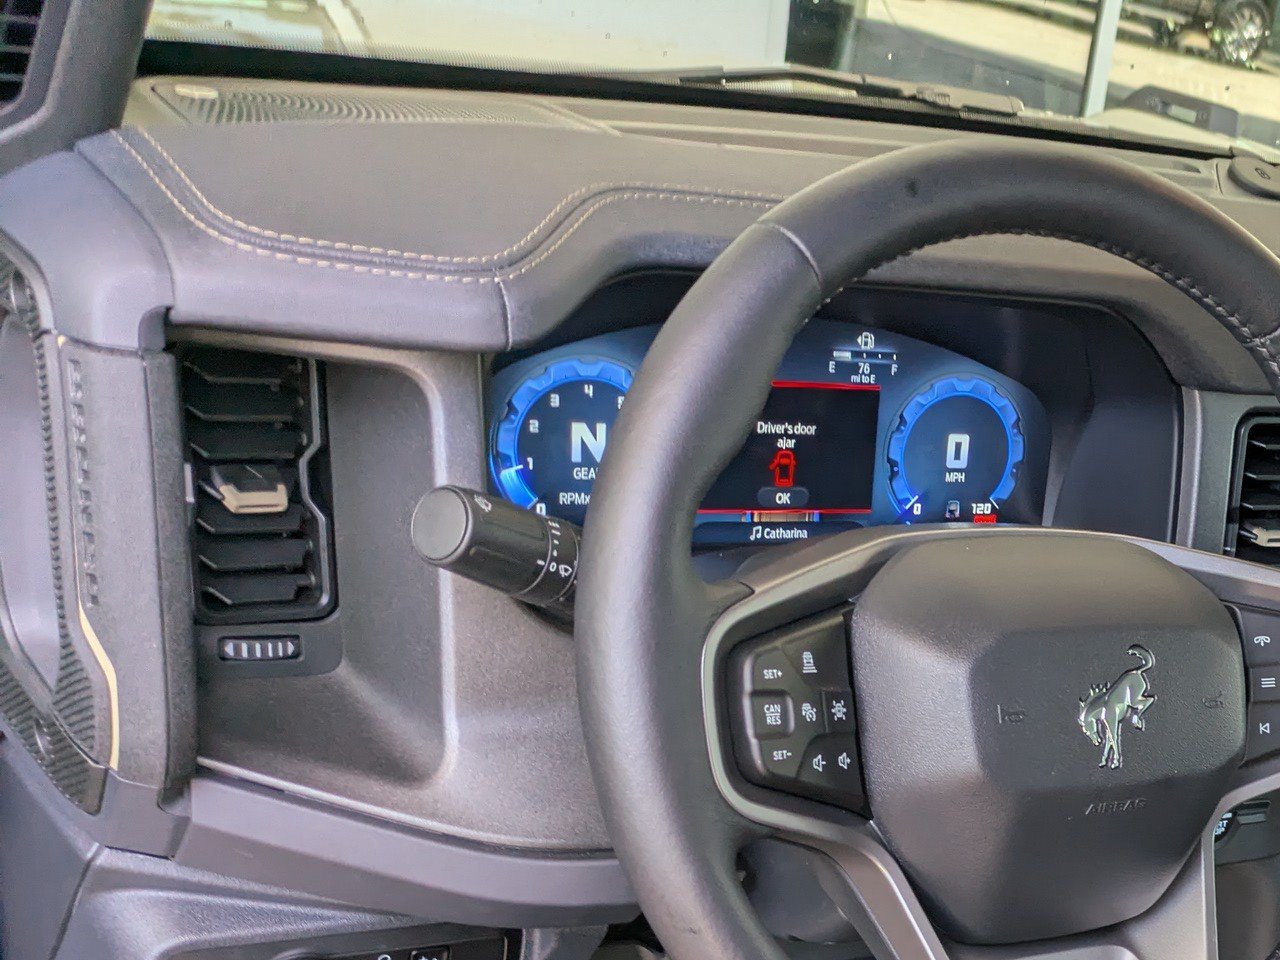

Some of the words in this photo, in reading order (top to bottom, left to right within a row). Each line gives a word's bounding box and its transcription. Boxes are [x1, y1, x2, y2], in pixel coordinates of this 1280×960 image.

[829, 361, 836, 373] E
[858, 363, 870, 375] 76
[891, 364, 898, 376] F
[850, 373, 861, 384] mi
[861, 374, 870, 384] to
[869, 374, 876, 384] E
[583, 384, 594, 398] 4
[550, 393, 560, 408] 3
[529, 419, 539, 434] 2
[756, 421, 794, 435] Driver's
[794, 422, 818, 436] door
[571, 421, 607, 464] N
[776, 437, 796, 449] ajar
[945, 433, 970, 469] 0
[526, 456, 534, 470] 1
[573, 467, 599, 481] GEA
[945, 472, 966, 483] MPH
[775, 492, 791, 504] OK
[536, 502, 547, 516] 0
[913, 503, 922, 515] 0
[971, 503, 992, 515] 120
[763, 527, 808, 539] Catharina
[763, 669, 783, 680] SET+
[764, 704, 781, 714] CAN
[766, 716, 782, 726] RES
